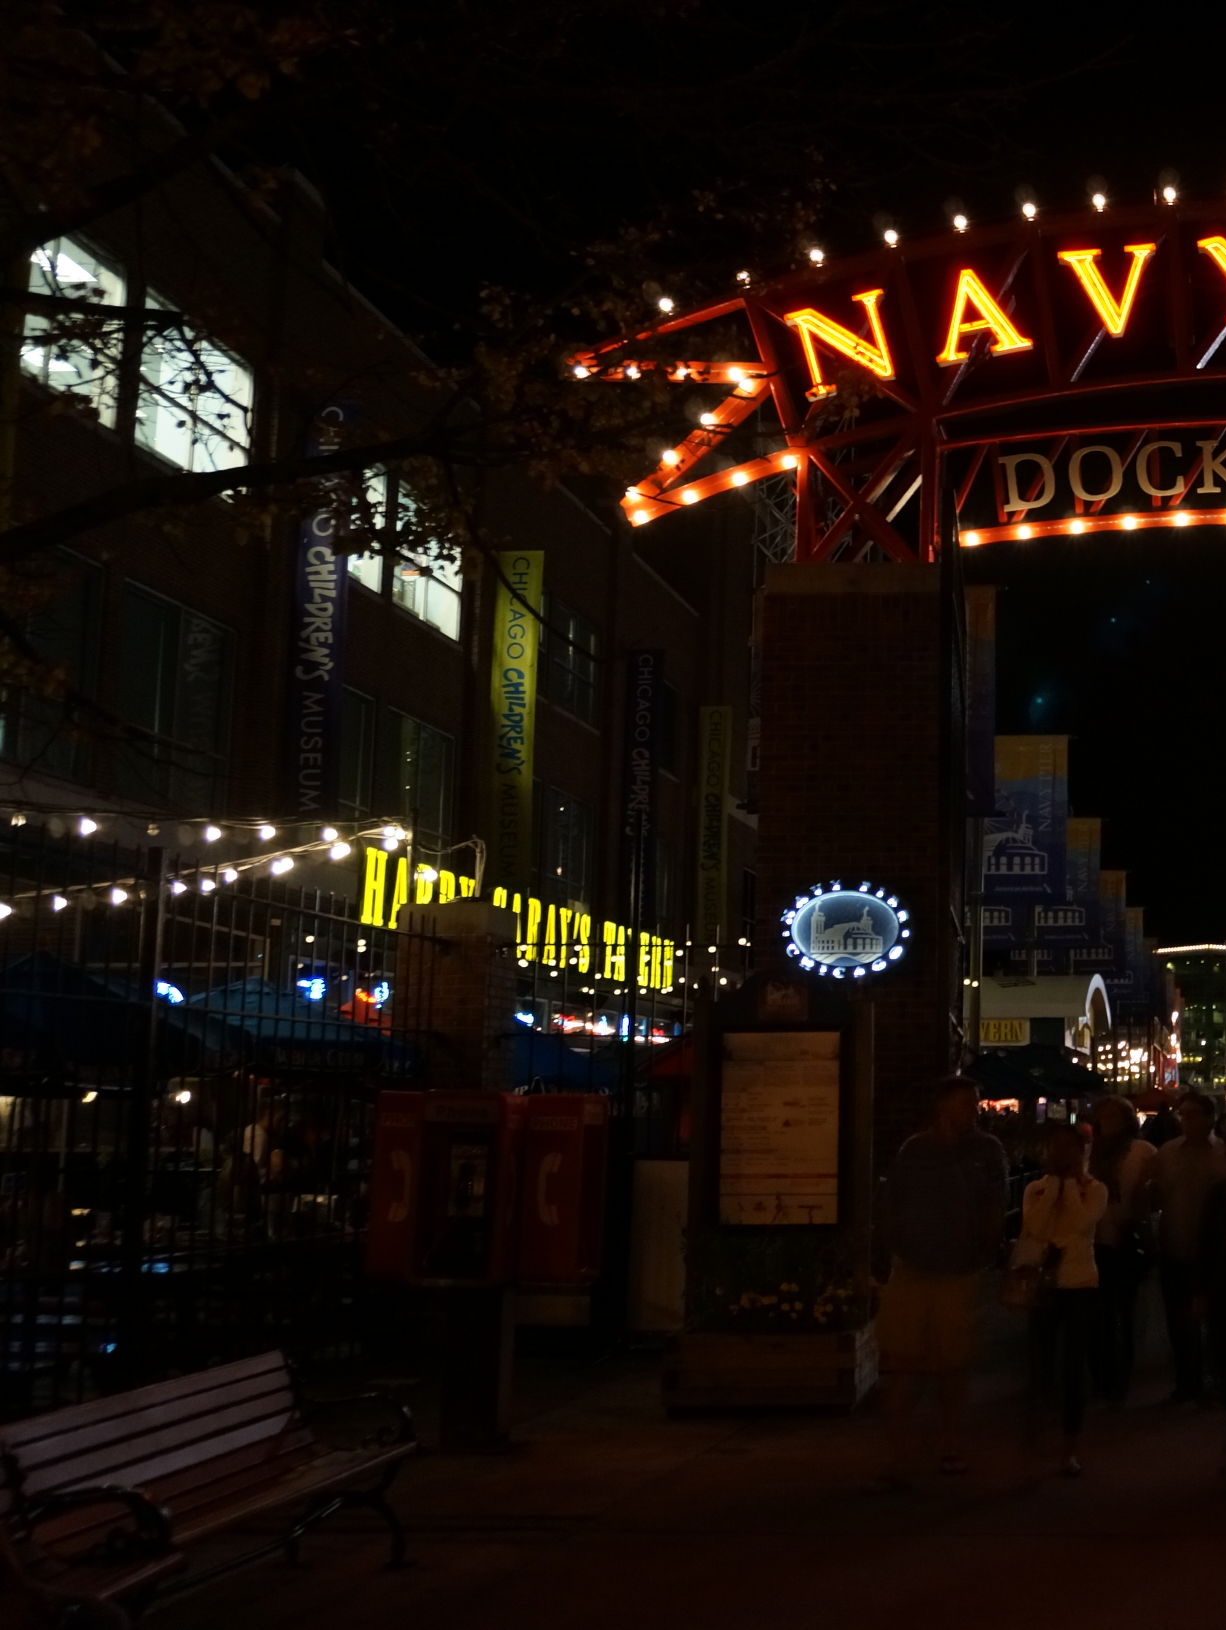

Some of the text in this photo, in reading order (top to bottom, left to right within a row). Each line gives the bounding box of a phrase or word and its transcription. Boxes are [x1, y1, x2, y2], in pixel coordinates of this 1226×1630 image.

[295, 546, 339, 682] CHILDREN'S
[495, 556, 530, 877] CHICAGO CHILDREN'S MUSEUM
[634, 653, 653, 742] CHICAGO
[297, 690, 325, 811] MUSEUM
[706, 709, 723, 789] CHICAGO
[603, 920, 675, 990] TAERN
[964, 1020, 1025, 1041] VERN
